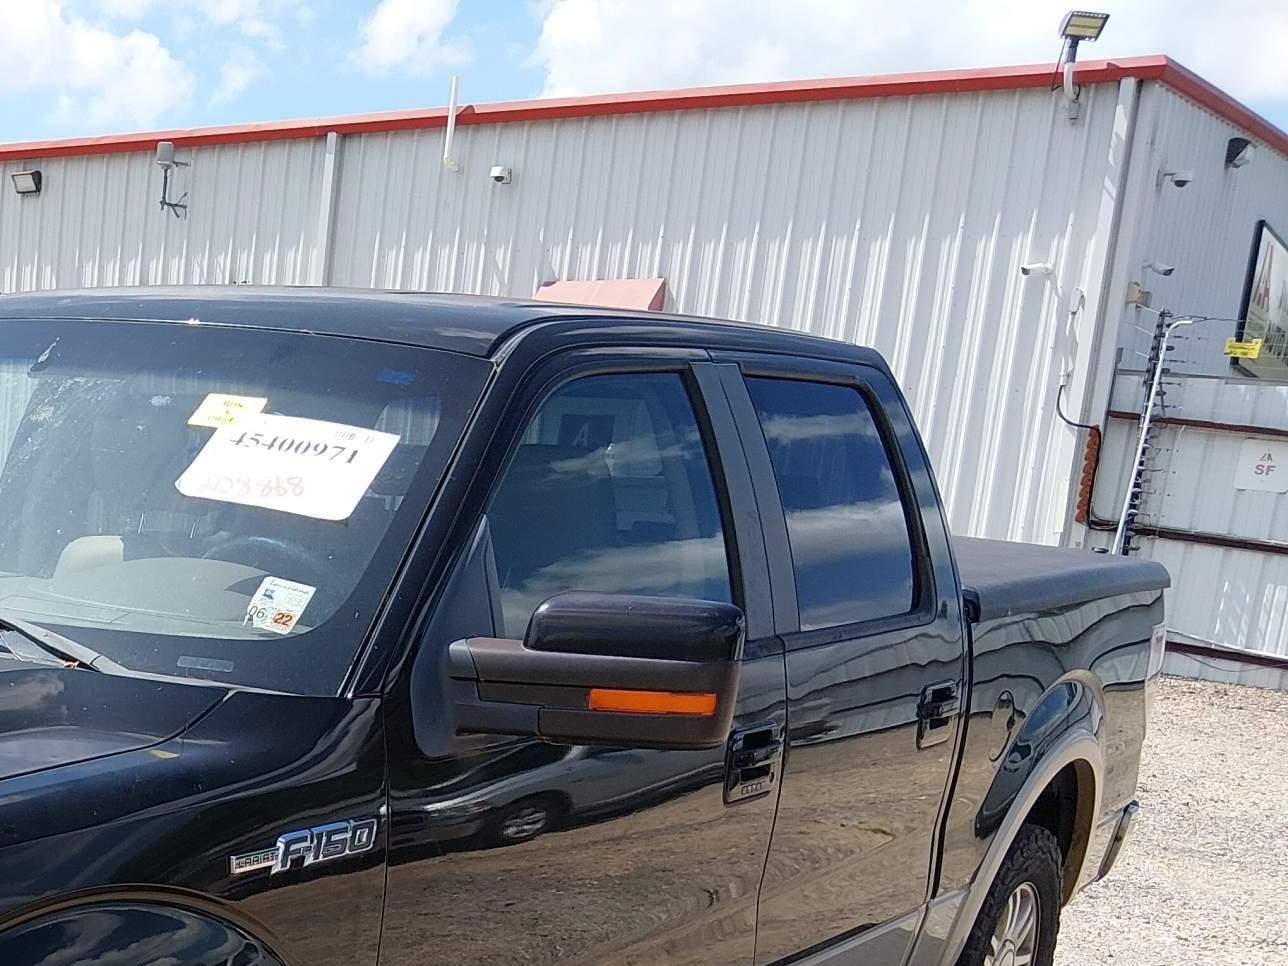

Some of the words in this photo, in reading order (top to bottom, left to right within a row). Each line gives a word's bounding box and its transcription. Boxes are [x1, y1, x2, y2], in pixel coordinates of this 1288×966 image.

[229, 431, 359, 464] 45400971
[1254, 464, 1276, 476] SF
[248, 605, 267, 619] 06
[273, 612, 293, 626] 22
